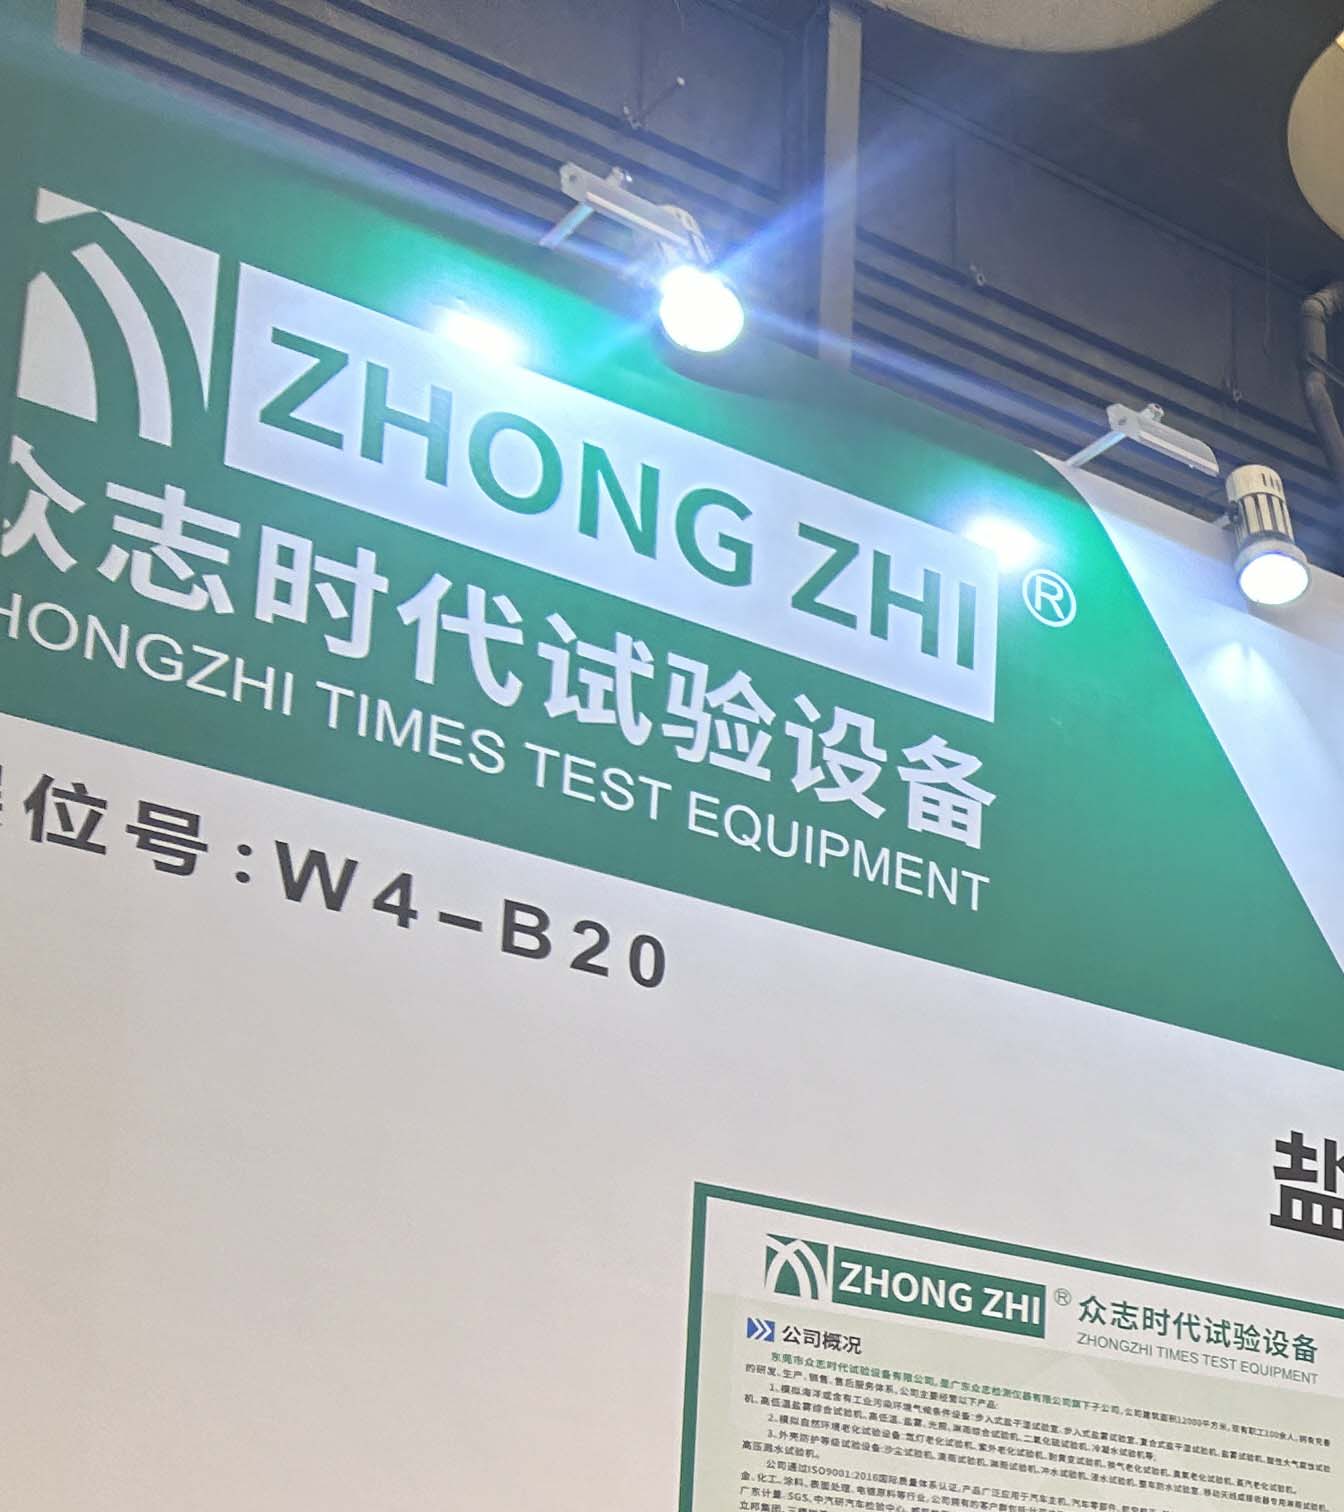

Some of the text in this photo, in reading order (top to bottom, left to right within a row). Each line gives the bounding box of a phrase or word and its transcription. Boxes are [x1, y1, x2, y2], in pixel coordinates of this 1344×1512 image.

[258, 328, 753, 586] ZHONG
[790, 523, 978, 670] ZHI
[0, 436, 996, 849] 众志时代试验设备
[0, 593, 990, 911] HONGZHI TIMES TEST EQUIPMENT
[839, 1261, 972, 1312] ZHONG
[981, 1287, 1040, 1324] ZHI
[782, 1325, 862, 1354] 公司概况
[1077, 1332, 1318, 1385] ZHONGZHI TIMES TEST EQUIPMENT
[1078, 1294, 1318, 1364] 众志时代试验设备
